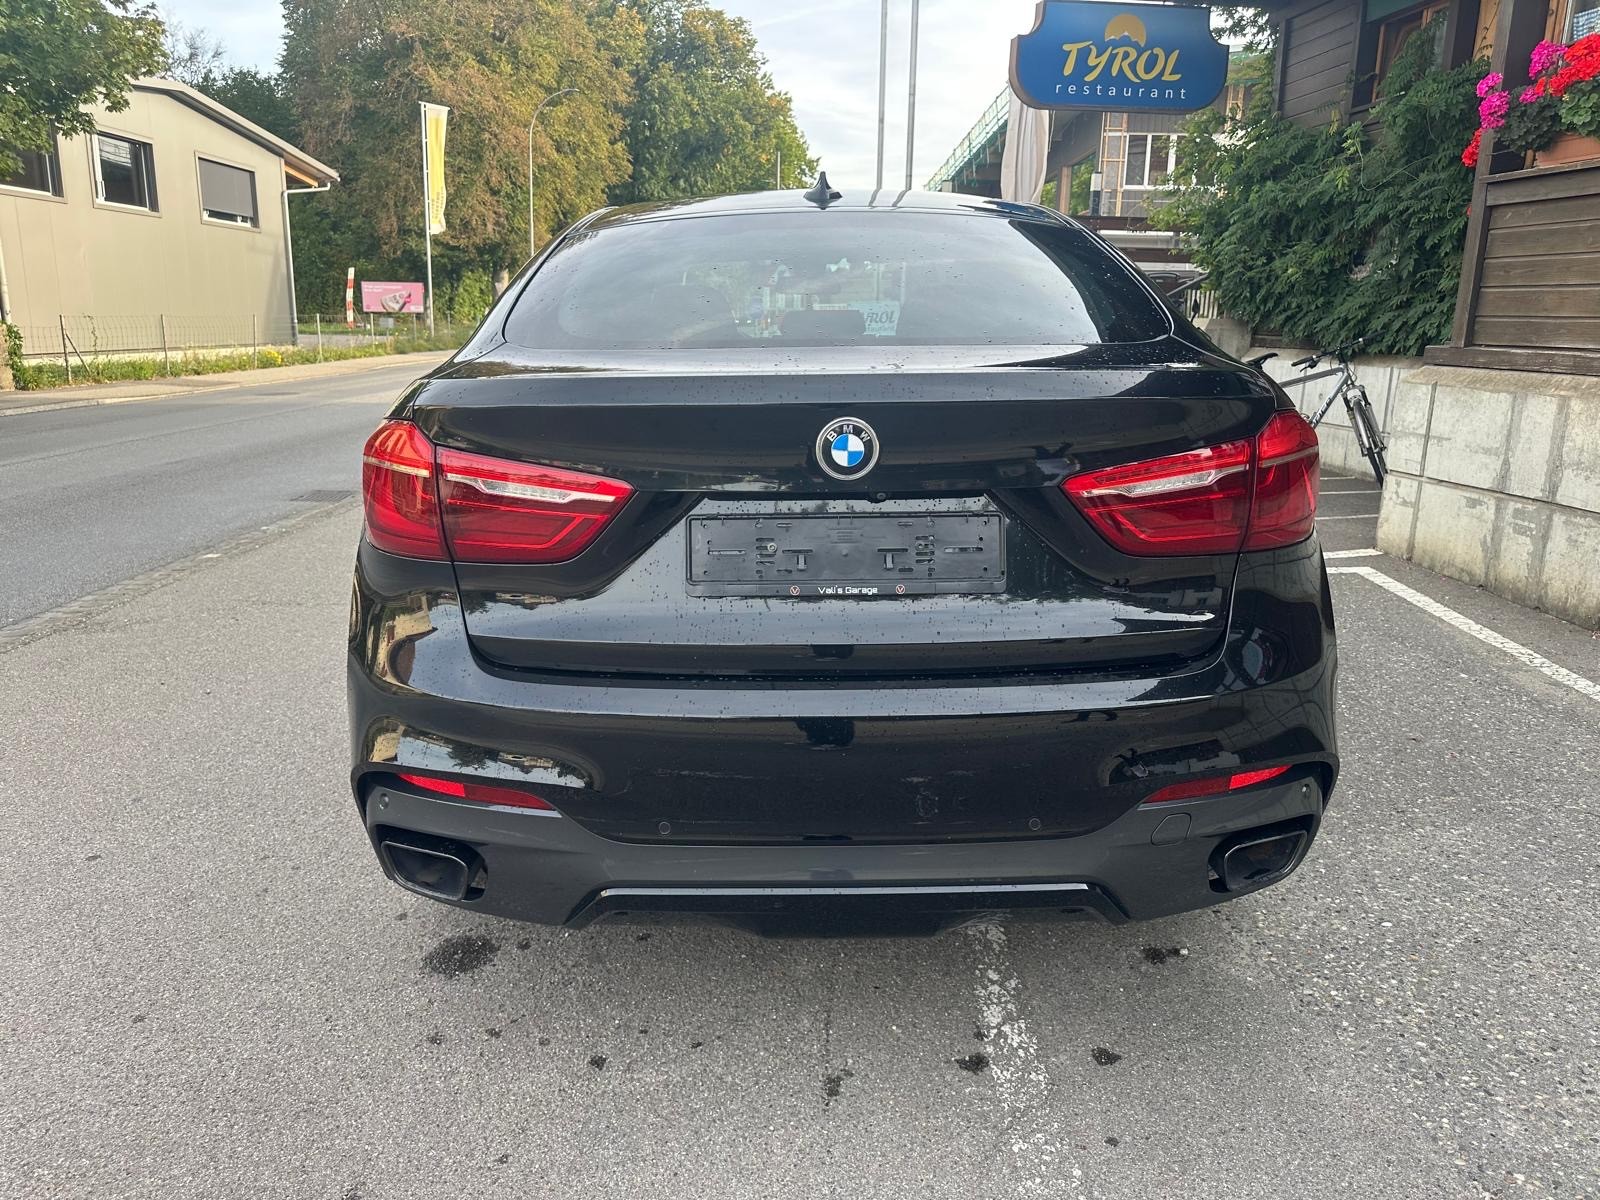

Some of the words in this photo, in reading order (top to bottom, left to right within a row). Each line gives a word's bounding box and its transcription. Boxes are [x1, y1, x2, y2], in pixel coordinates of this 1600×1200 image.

[1062, 41, 1181, 82] TYROL
[1055, 83, 1186, 99] restaurant
[826, 424, 871, 442] BMW
[818, 585, 843, 594] Vali's
[845, 586, 878, 595] Garage
